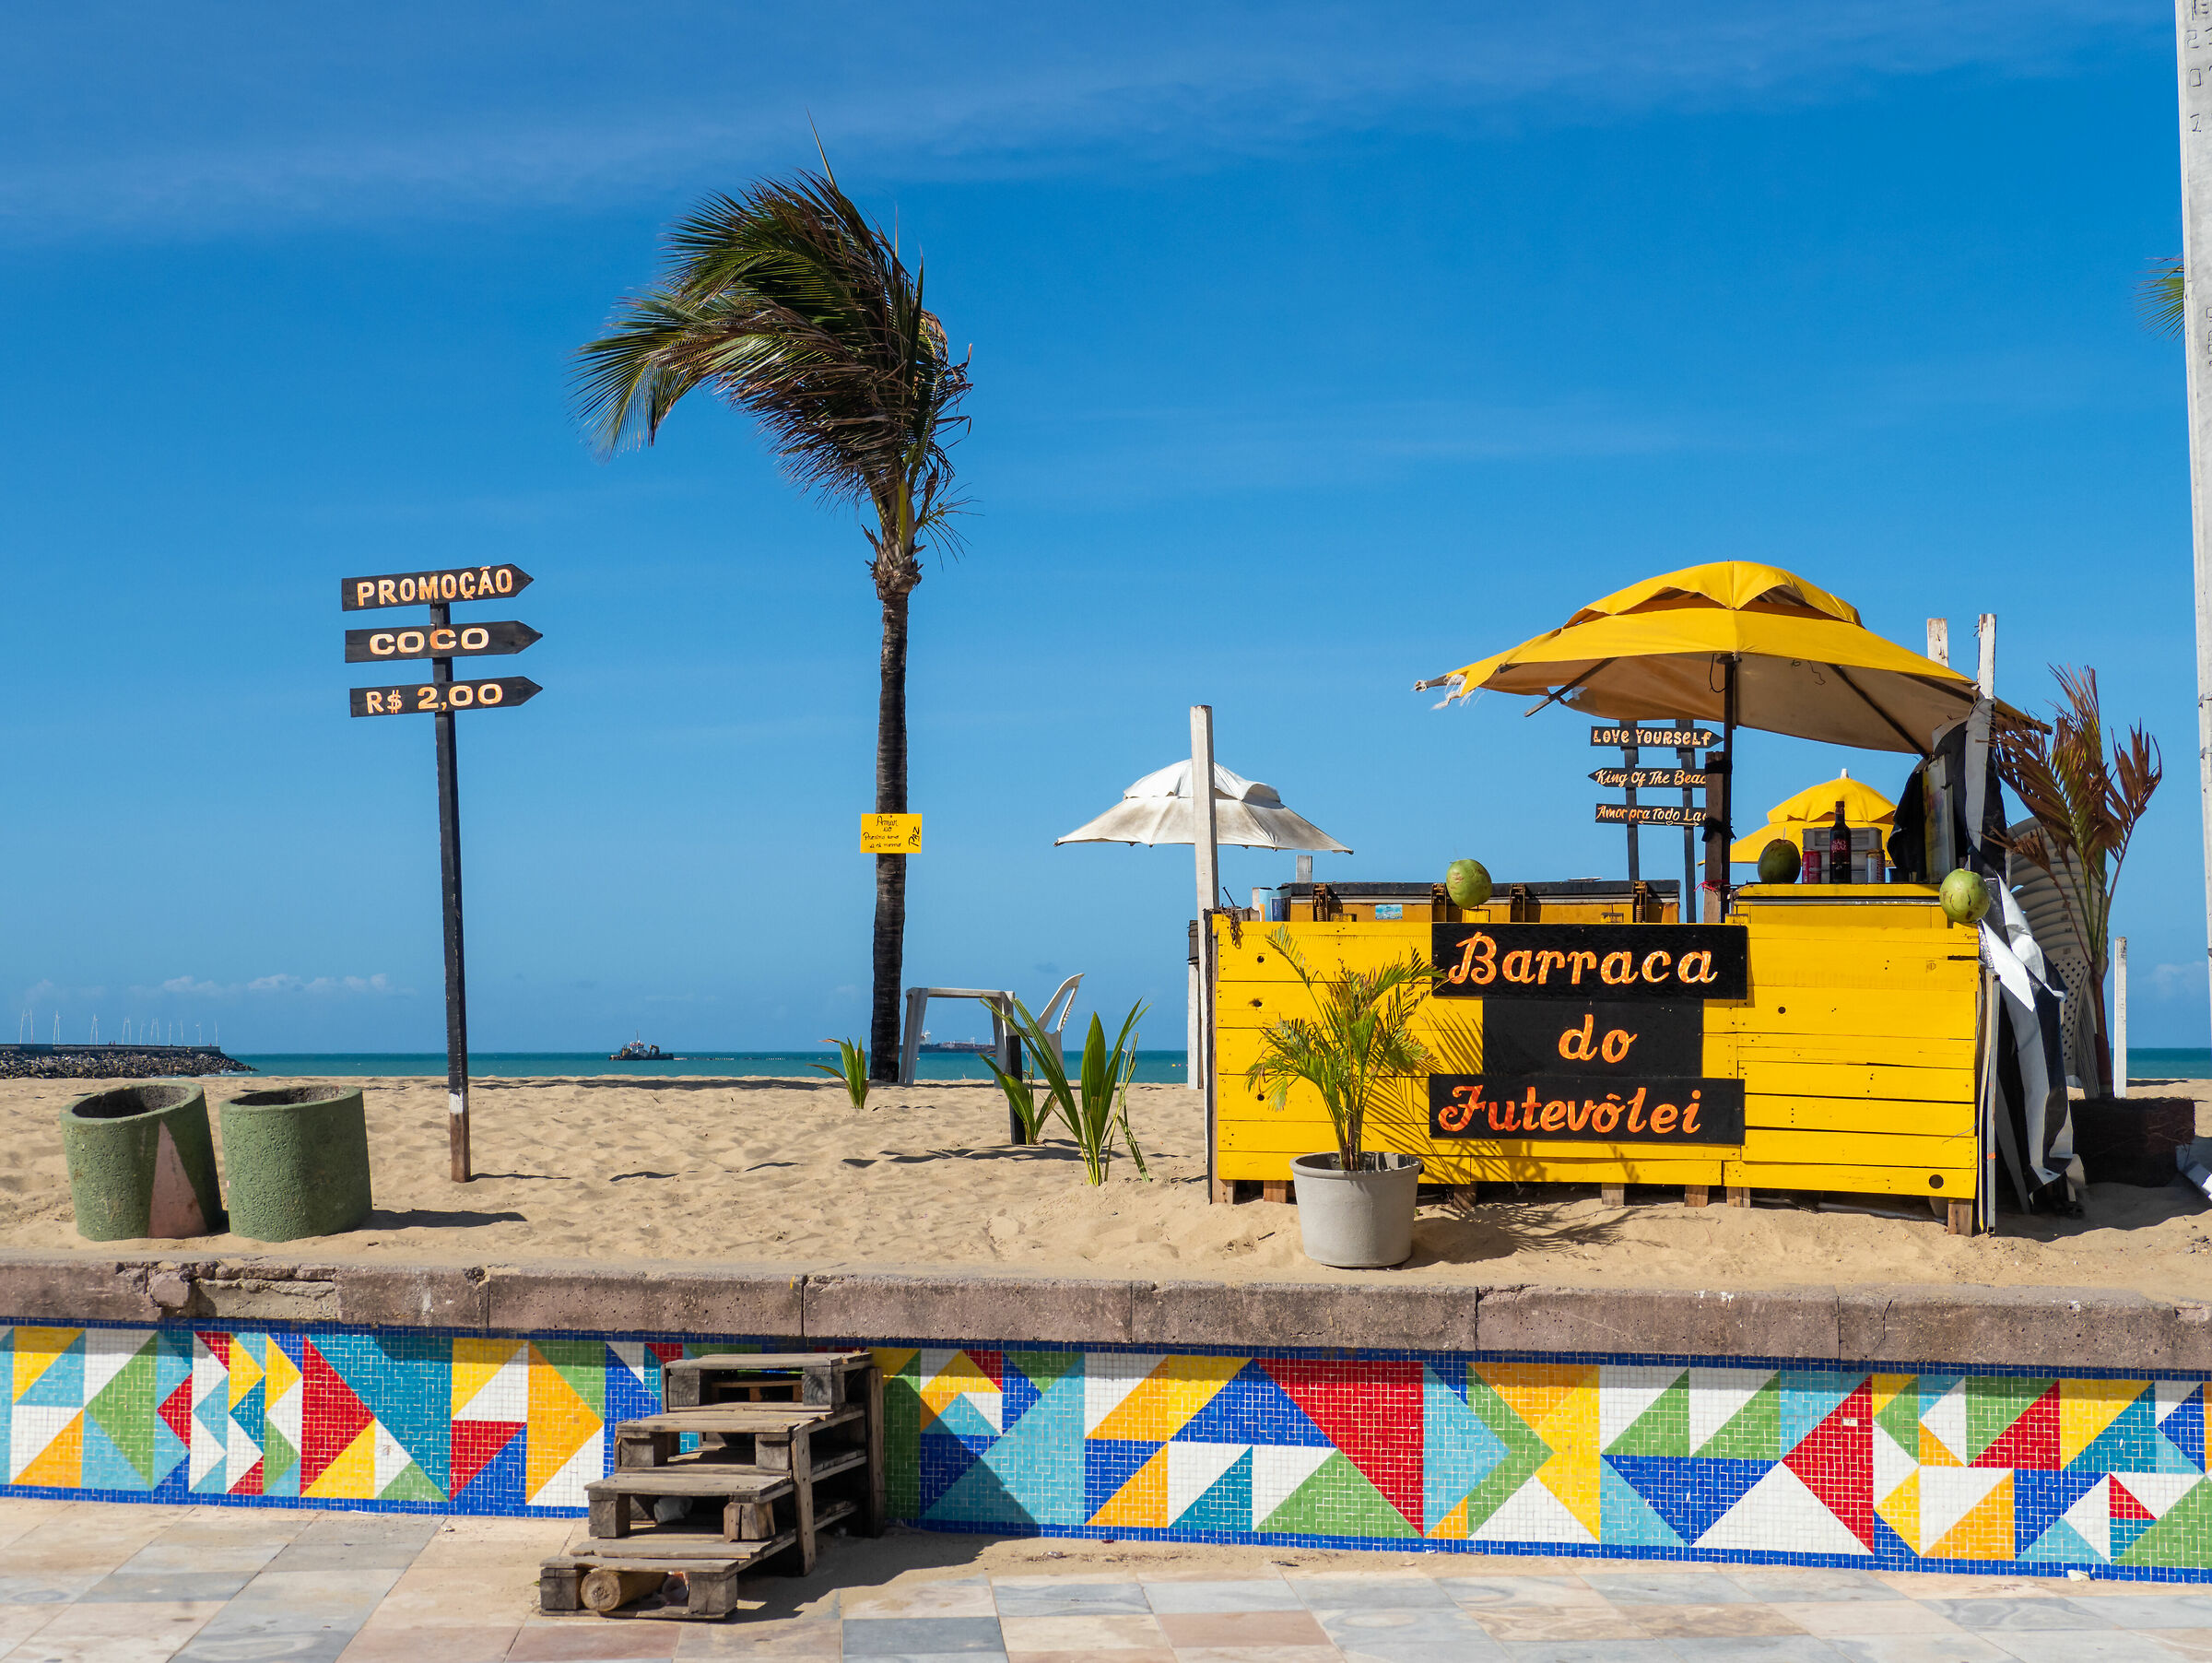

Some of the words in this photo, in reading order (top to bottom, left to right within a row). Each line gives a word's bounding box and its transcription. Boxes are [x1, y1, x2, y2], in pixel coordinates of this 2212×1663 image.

[357, 565, 512, 606] PROMOÇÃO
[370, 628, 489, 655] COCO
[366, 690, 403, 714] R$
[418, 683, 503, 711] 2,00
[1595, 770, 1628, 787] King
[1630, 771, 1646, 787] Of
[1648, 771, 1670, 785] The
[1596, 805, 1628, 819] Amor
[1629, 809, 1650, 821] pra
[1653, 808, 1680, 820] Todo
[1448, 931, 1718, 985] Barraca
[1559, 1014, 1638, 1064] do
